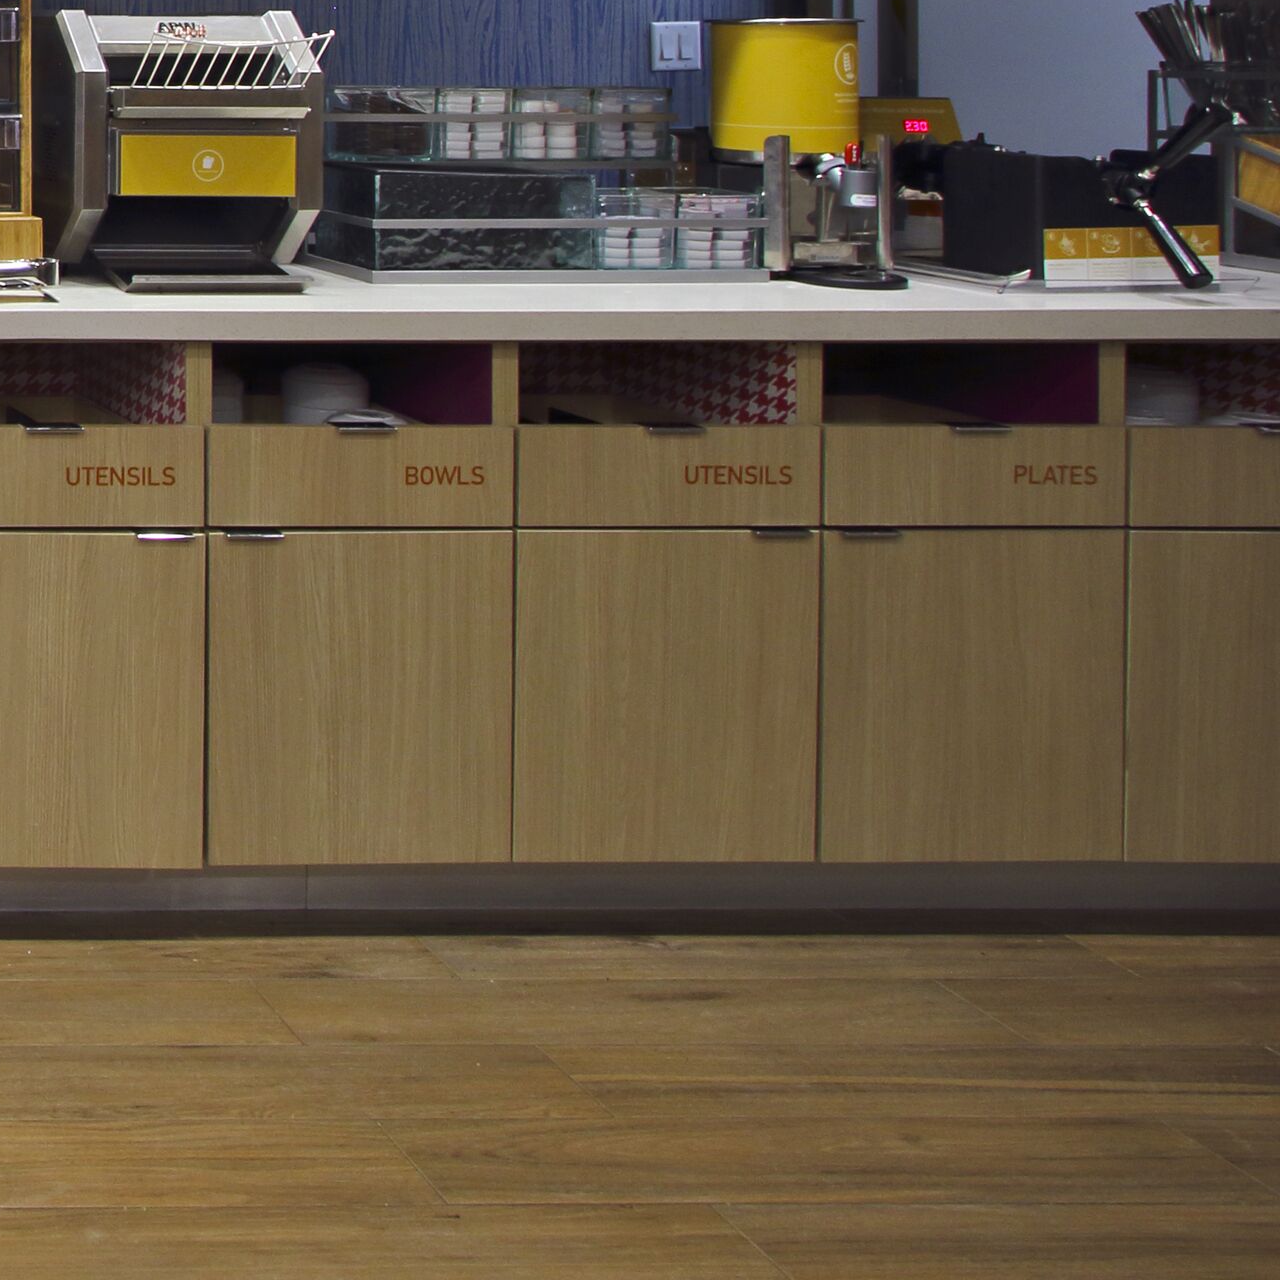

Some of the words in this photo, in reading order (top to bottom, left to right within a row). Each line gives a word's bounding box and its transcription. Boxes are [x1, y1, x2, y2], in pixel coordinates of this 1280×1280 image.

[64, 465, 177, 487] UTENSILS
[403, 465, 485, 486] BOWLS
[683, 464, 793, 486] UTENSILS
[1012, 464, 1098, 486] PLATES
